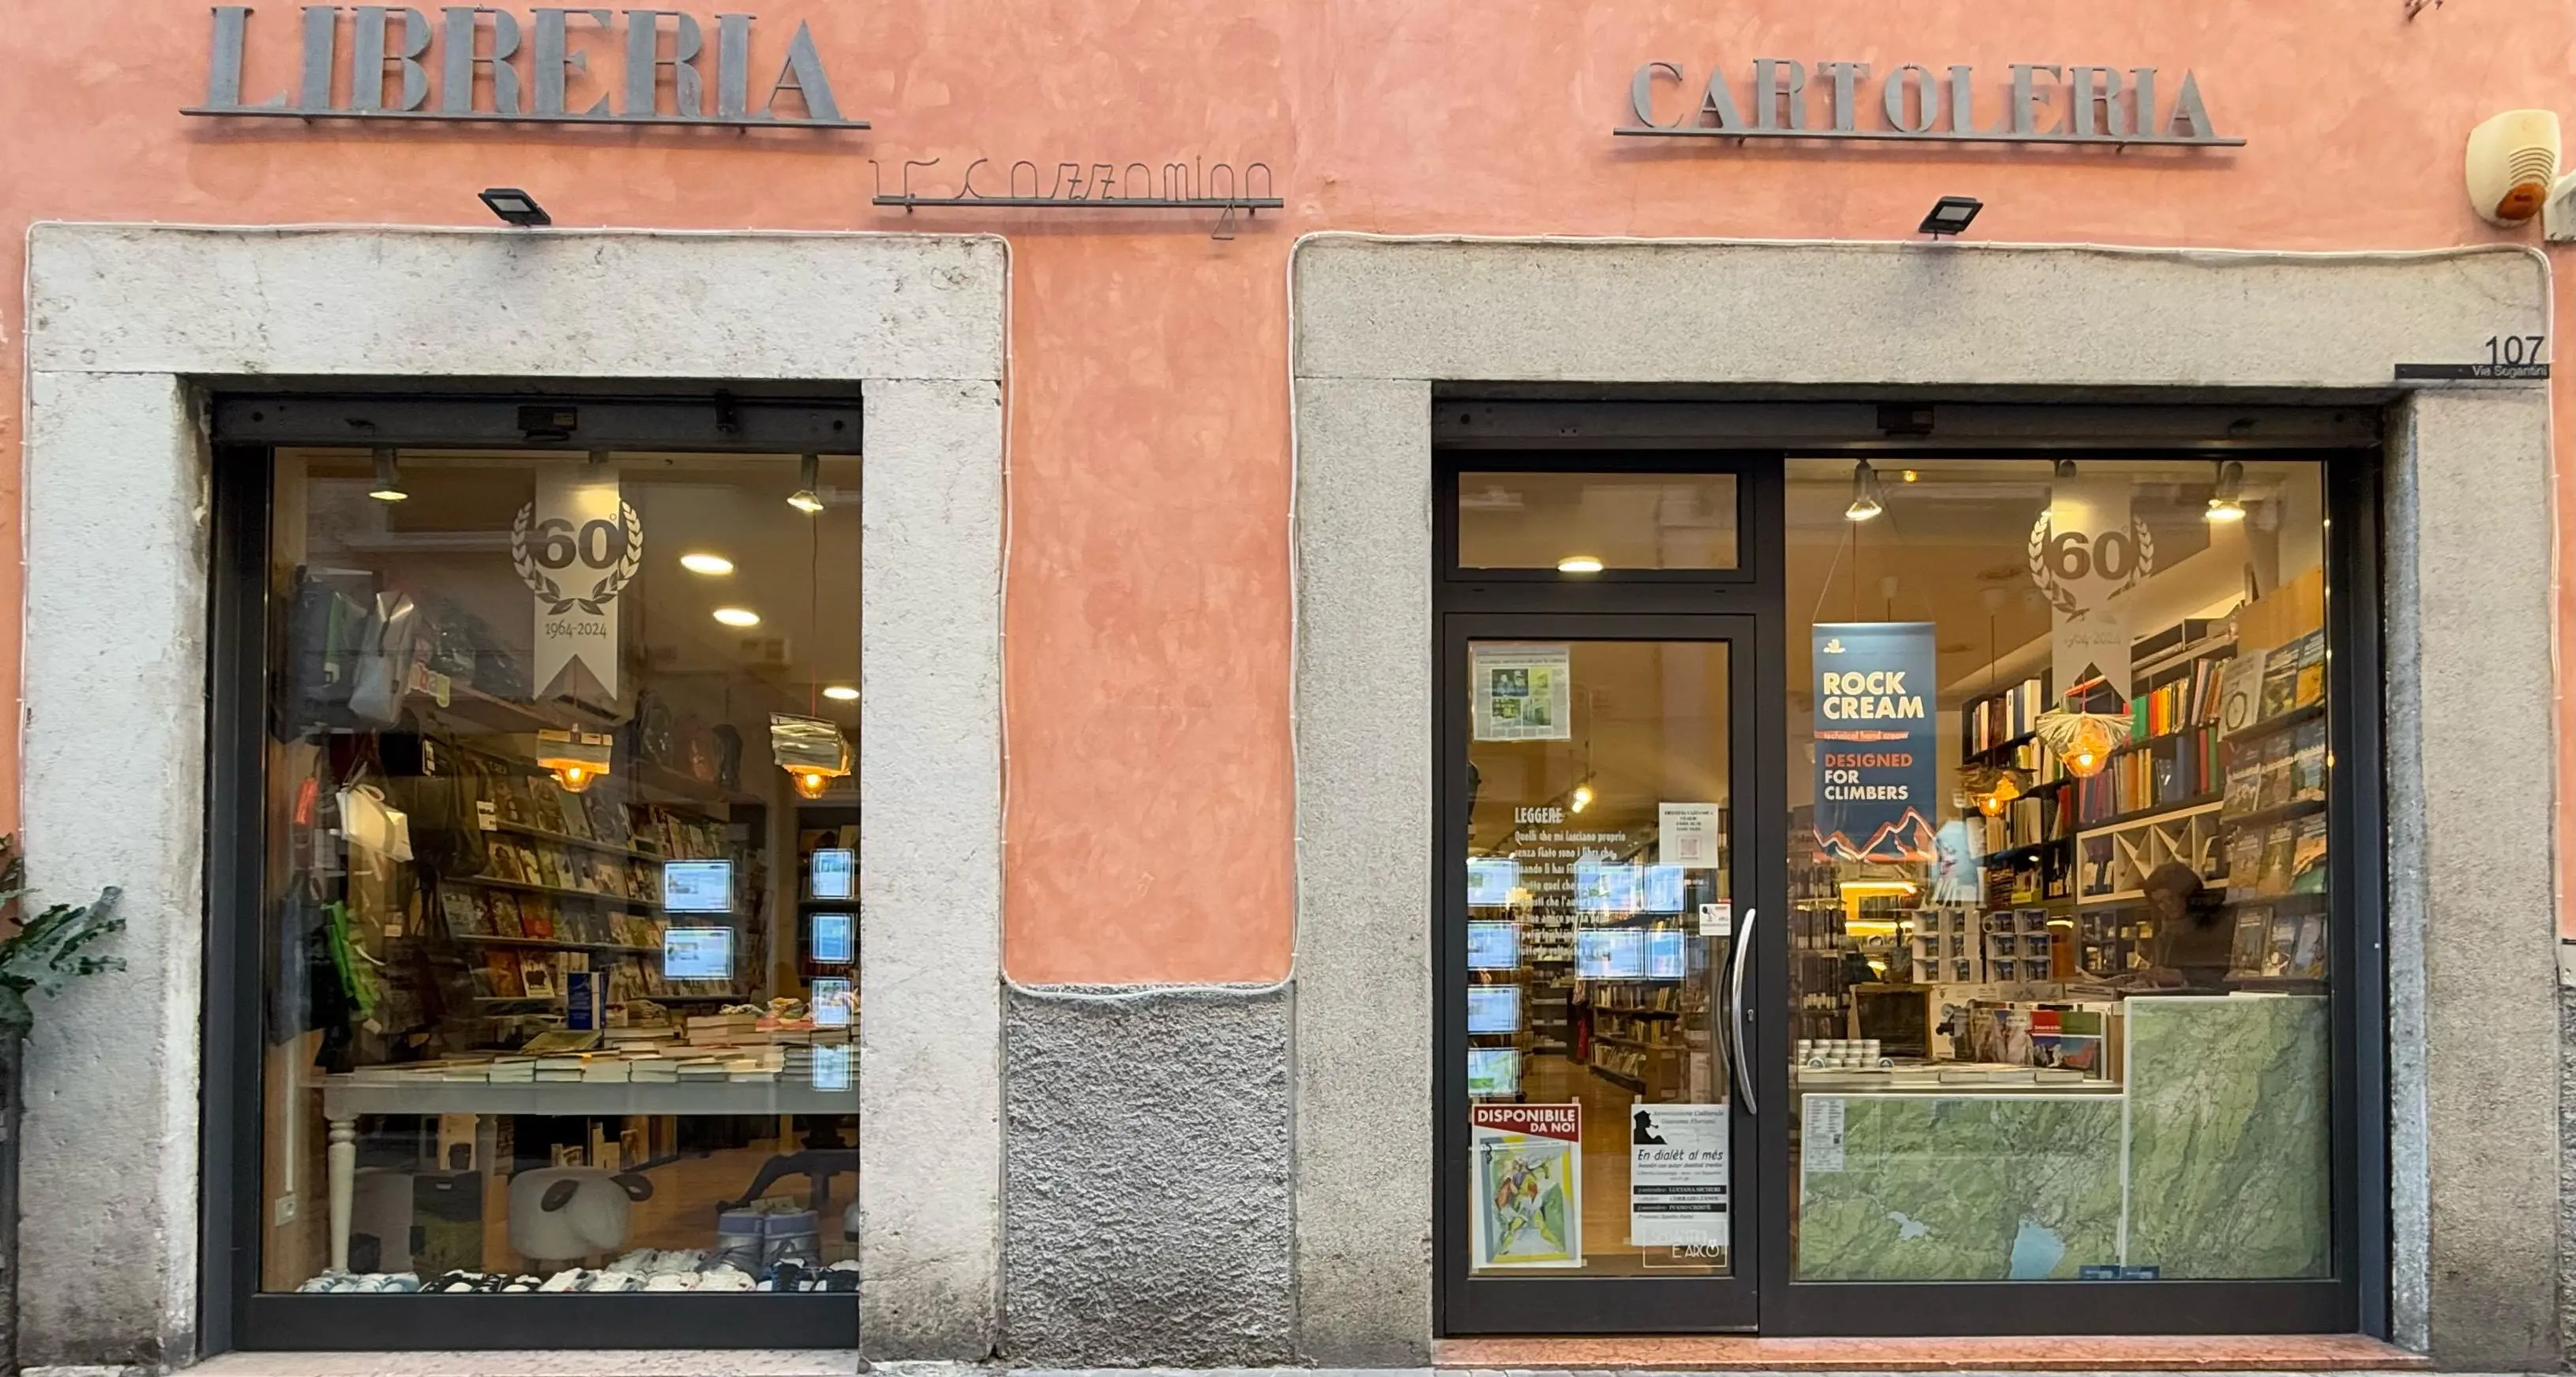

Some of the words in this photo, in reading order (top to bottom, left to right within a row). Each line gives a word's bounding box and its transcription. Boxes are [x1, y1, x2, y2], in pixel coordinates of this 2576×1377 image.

[208, 6, 848, 122] LIBRERIA
[1632, 58, 2222, 138] CARTOLERIA
[2485, 336, 2544, 365] 107
[2472, 366, 2491, 377] Via
[545, 619, 607, 640] 1964-2024
[1823, 671, 1906, 696] ROCK
[1823, 696, 1924, 719] CREAM
[1825, 753, 1913, 767] DESIGNED
[1825, 770, 1859, 784] FOR
[1824, 786, 1909, 801] CLIMBERS
[1515, 807, 1563, 824] LEGGERE
[1515, 831, 1537, 846] Quelli
[1539, 830, 1553, 842] che
[1554, 831, 1564, 841] mi
[1566, 831, 1596, 842] lasciano
[1598, 830, 1626, 843] proprio
[1538, 846, 1556, 857] fiato
[1478, 1109, 1575, 1122] DISPONIBILE
[1530, 1122, 1548, 1132] DA
[1551, 1122, 1575, 1132] NOI
[1638, 1150, 1650, 1161] En
[1688, 1150, 1699, 1161] al
[1684, 1244, 1720, 1258] ARCO
